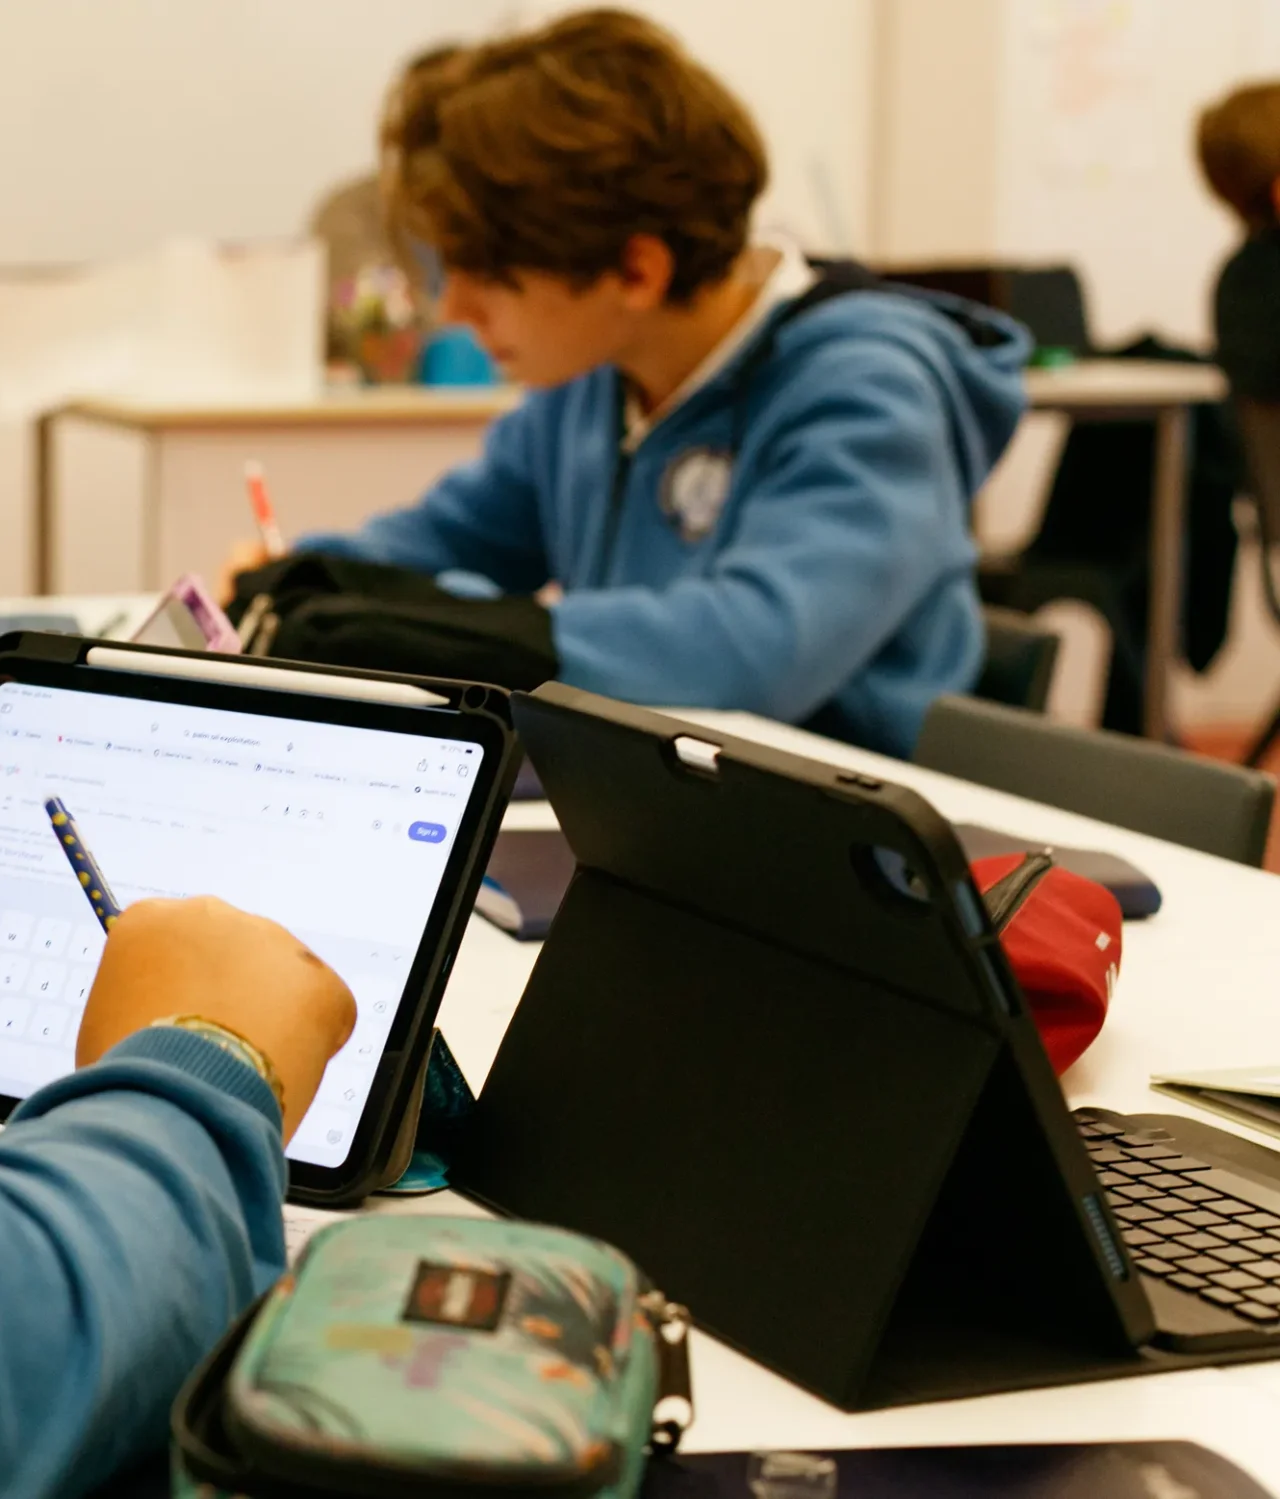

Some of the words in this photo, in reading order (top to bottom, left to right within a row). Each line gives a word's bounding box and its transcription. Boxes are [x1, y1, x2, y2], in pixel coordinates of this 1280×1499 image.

[192, 731, 210, 740] palm
[220, 735, 262, 747] exploitation
[416, 826, 432, 837] Sign
